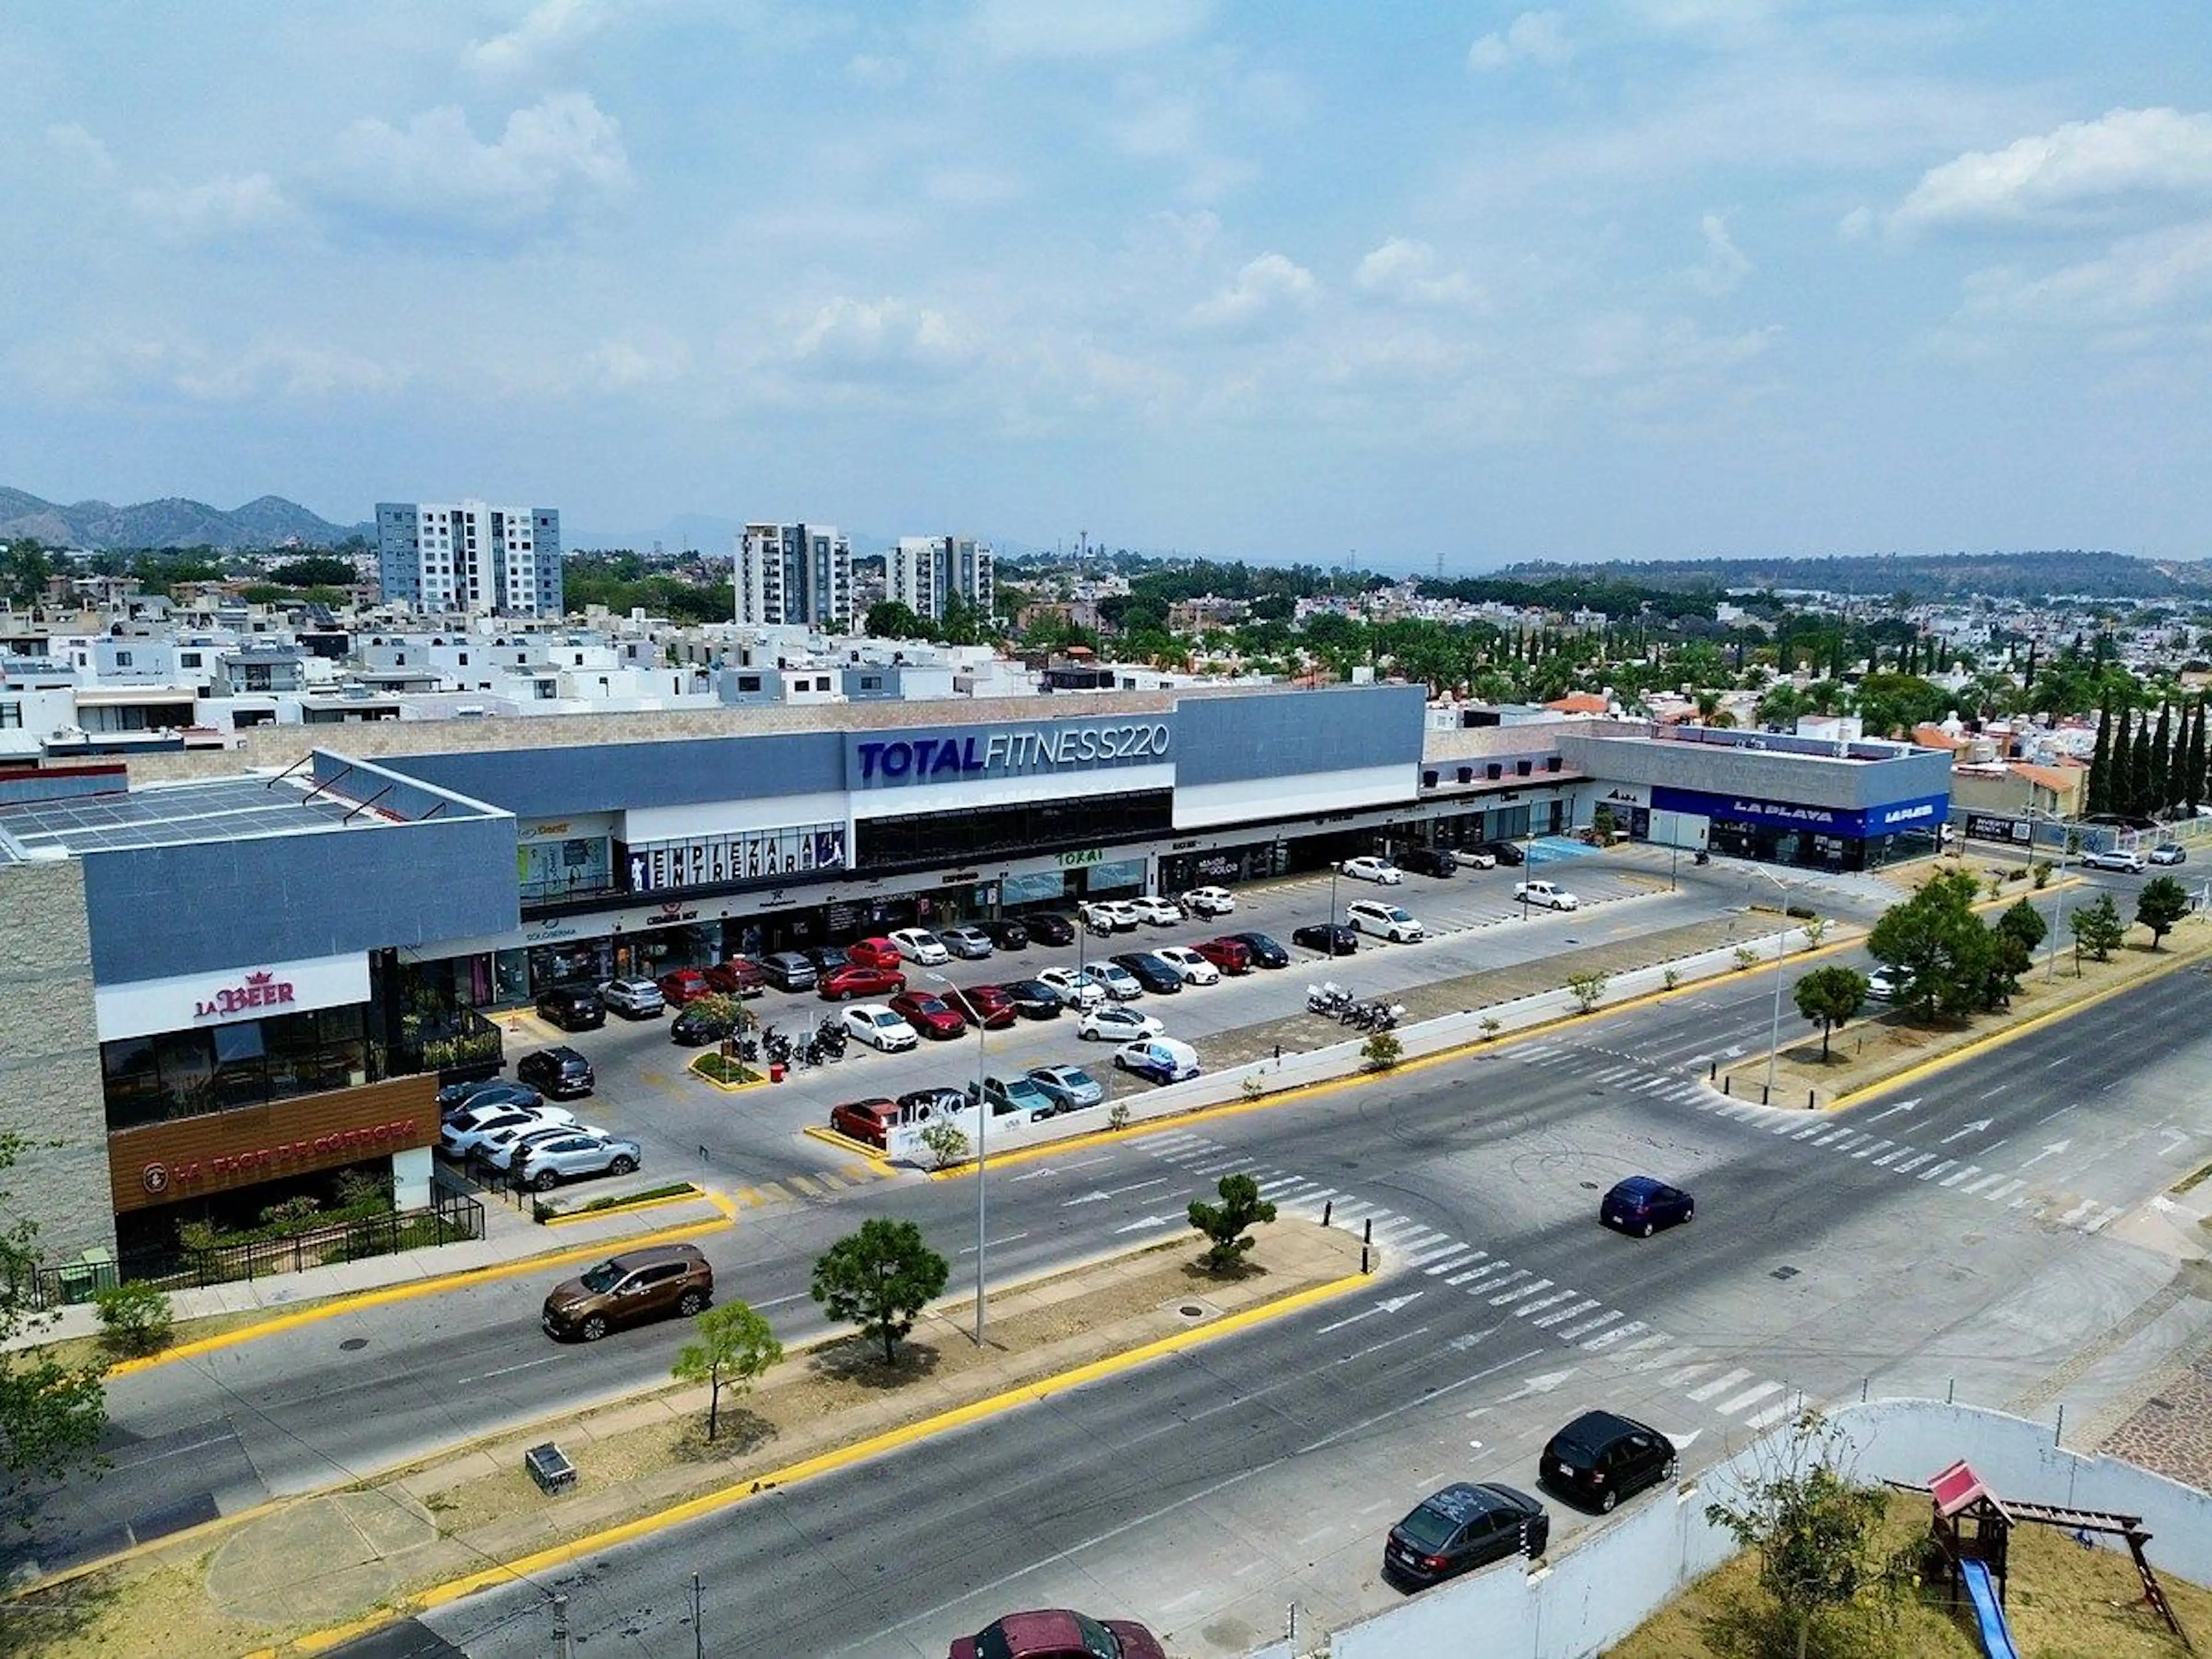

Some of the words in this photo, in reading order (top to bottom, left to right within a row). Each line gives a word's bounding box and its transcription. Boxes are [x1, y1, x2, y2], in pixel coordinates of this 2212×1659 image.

[654, 838, 776, 868] EMPIEZA
[654, 855, 795, 887] ENTRENAR
[194, 1000, 218, 1018] LA
[216, 982, 295, 1017] BEER
